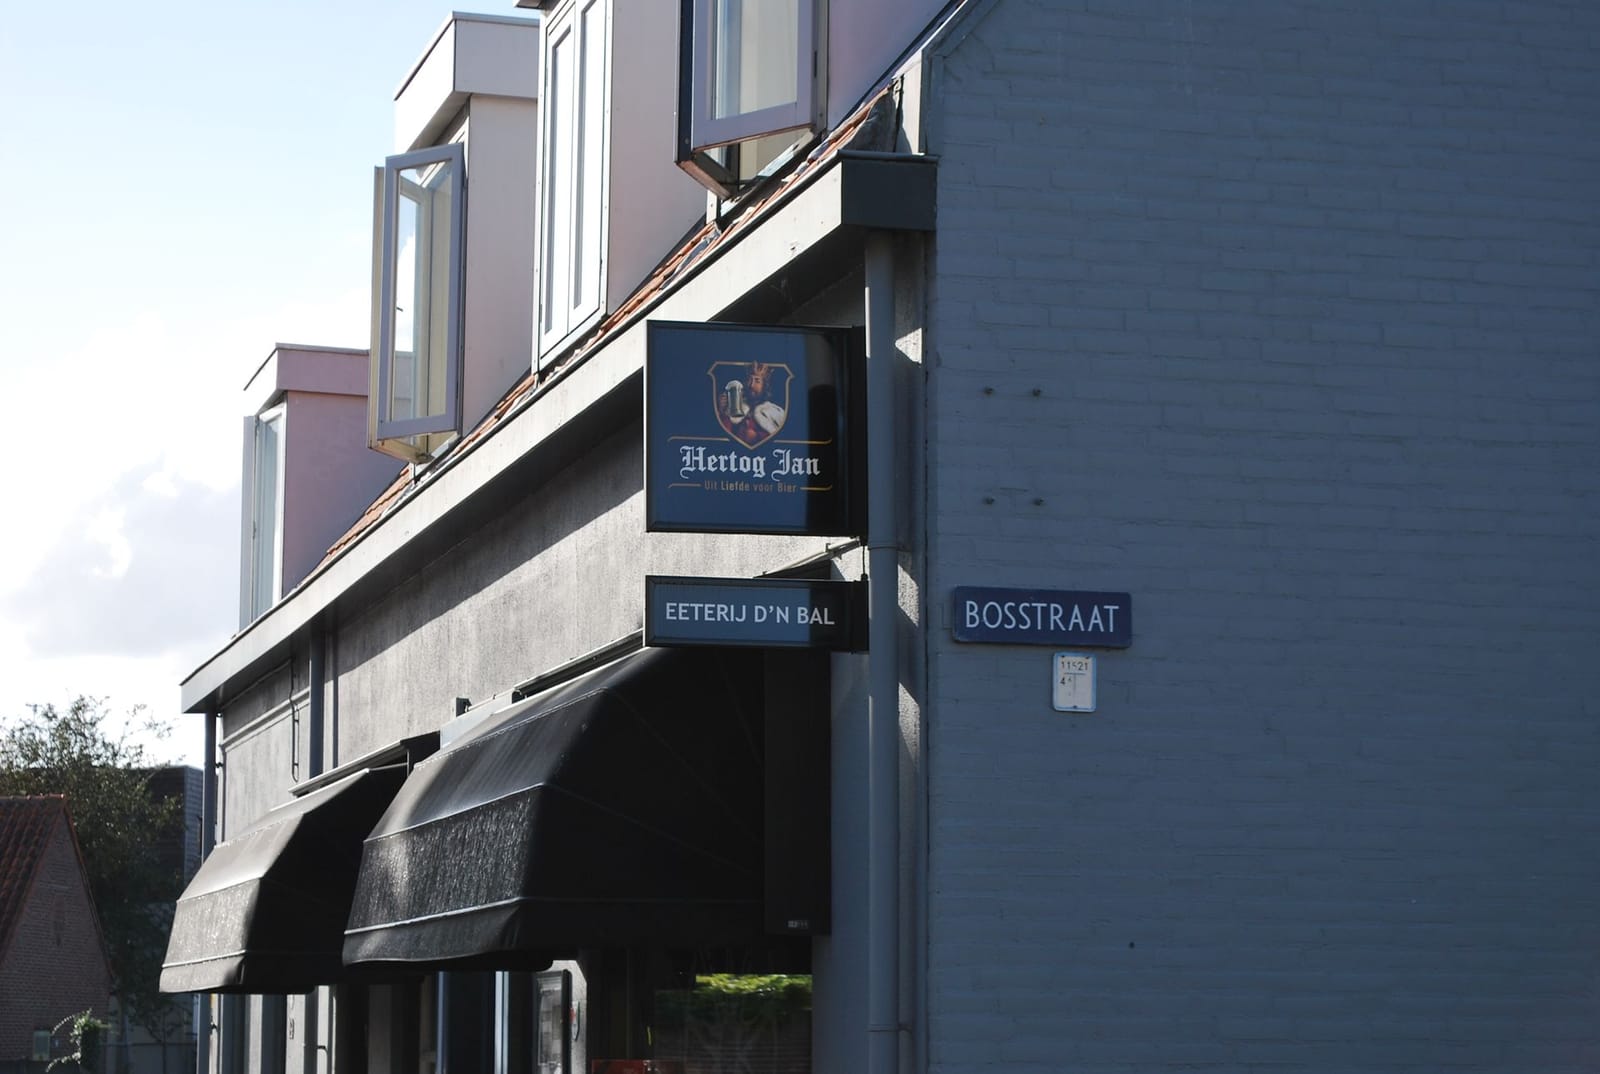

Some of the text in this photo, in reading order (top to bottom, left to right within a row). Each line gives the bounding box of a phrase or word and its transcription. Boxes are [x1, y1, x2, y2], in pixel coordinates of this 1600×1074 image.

[679, 445, 821, 482] Hertog Jan
[704, 480, 797, 493] Uit Liefde voor Bier
[665, 602, 835, 625] EETERIJ D'N BAL
[965, 600, 1119, 633] BOSSTRAAT
